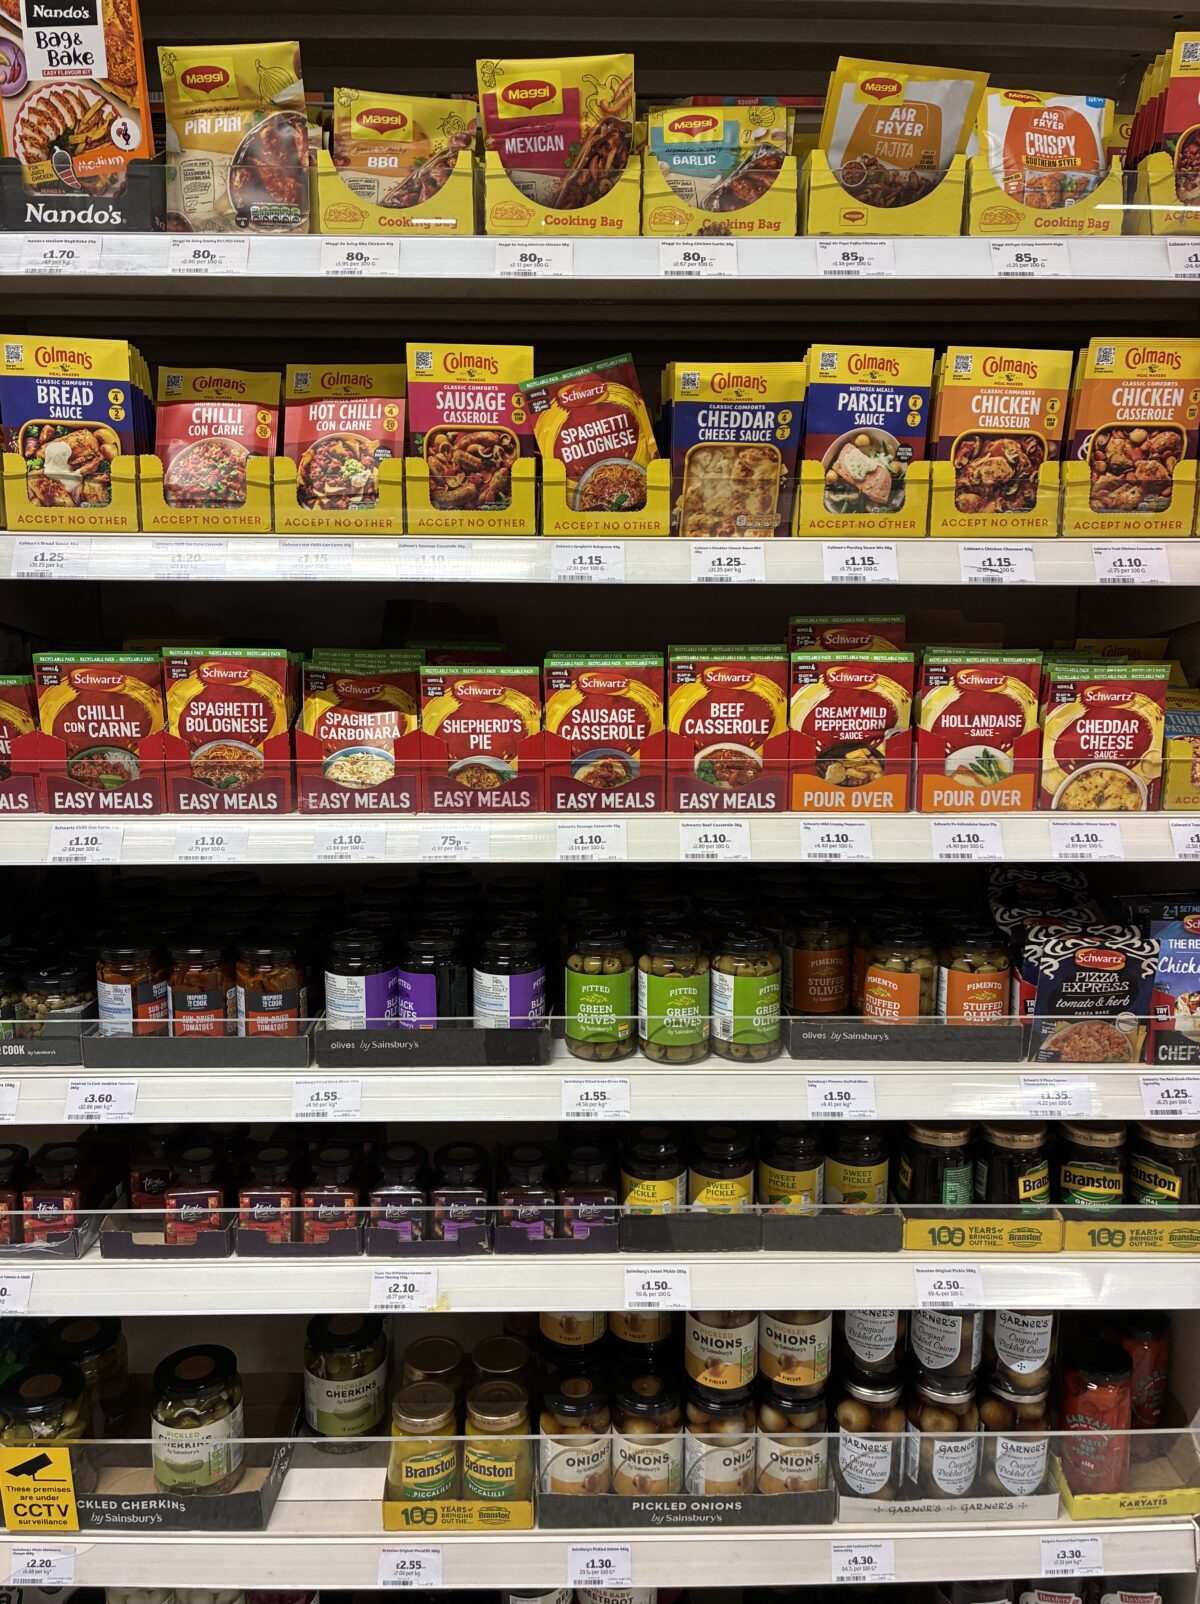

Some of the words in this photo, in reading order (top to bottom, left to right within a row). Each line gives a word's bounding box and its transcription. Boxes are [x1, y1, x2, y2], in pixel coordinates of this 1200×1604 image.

[33, 5, 89, 18] Nando's
[48, 48, 94, 67] Bake
[509, 86, 550, 100] Maggi
[866, 82, 896, 92] Maggi
[362, 115, 401, 126] Maggi
[890, 108, 916, 122] AIR
[184, 119, 211, 135] PIRI
[215, 120, 241, 133] PIRI
[875, 120, 923, 137] FRYER
[505, 135, 564, 154] MEXICAN
[875, 141, 914, 159] FAJITA
[1025, 132, 1076, 156] CRISPY
[368, 156, 398, 168] BBQ
[672, 155, 716, 165] GARLIC
[1025, 157, 1056, 166] SOUTHERN
[1058, 158, 1077, 166] STYLE
[24, 203, 122, 224] Nando's
[544, 215, 597, 228] Cooking
[600, 215, 623, 228] Bag
[1034, 218, 1084, 230] Cooking
[1087, 218, 1110, 230] Bag
[44, 250, 74, 259] £1.70
[192, 250, 216, 260] 80p
[346, 252, 369, 262] 80p
[683, 252, 706, 262] 80p
[842, 252, 865, 262] 85p
[1015, 253, 1038, 264] 85p
[35, 346, 92, 370] Colman's
[848, 354, 899, 377] Colman's
[193, 376, 246, 393] Colman's
[710, 372, 767, 394] Colman's
[37, 386, 94, 406] BREAD
[562, 385, 605, 404] Schwartz
[1112, 388, 1184, 407] CHICKEN
[436, 392, 506, 411] SAUSAGE
[838, 393, 904, 412] PARSLEY
[49, 406, 83, 419] SAUCE
[192, 408, 242, 424] CHILLI
[309, 404, 336, 420] HOT
[340, 404, 381, 419] CHILLI
[443, 411, 499, 424] CASSEROLE
[1116, 409, 1174, 420] CASSEROLE
[698, 410, 775, 429] CHEDDAR
[854, 413, 885, 425] SAUCE
[979, 416, 1030, 428] CHASSEUR
[188, 425, 207, 436] CON
[211, 425, 244, 436] CARNE
[316, 421, 337, 431] CON
[340, 421, 372, 431] CARNE
[561, 414, 628, 445] SPAGHETTI
[698, 429, 736, 441] CHEESE
[739, 430, 772, 441] SAUCE
[561, 429, 636, 464] BOLOGNESE
[18, 515, 64, 524] ACCEPT
[69, 516, 85, 524] NO
[88, 516, 127, 525] OTHER
[34, 552, 64, 562] £1.25
[712, 557, 741, 567] £1.25
[845, 557, 874, 566] £1.15
[982, 558, 1011, 567] £1.15
[1113, 558, 1142, 568] £1.10
[202, 667, 249, 678] Schwartz
[828, 672, 874, 683] Schwartz
[74, 674, 121, 685] Schwartz
[77, 705, 125, 720] CHILLI
[190, 703, 263, 717] SPAGHETTI
[710, 703, 745, 717] BEEF
[815, 707, 859, 718] CREAMY
[861, 707, 886, 718] MILD
[326, 712, 396, 726] SPAGHETTI
[572, 709, 635, 724] SAUSAGE
[941, 714, 1022, 728] HOLLANDAISE
[64, 723, 85, 733] CON
[88, 722, 141, 737] CARNE
[186, 717, 268, 733] BOLOGNESE
[443, 719, 522, 734] SHEPHERD'S
[685, 719, 769, 735] CASSEROLE
[815, 719, 886, 731] PEPPERCORN
[1076, 719, 1139, 734] CHEDDAR
[320, 726, 400, 740] CARBONARA
[840, 732, 863, 740] SAUCE
[470, 735, 492, 750] PIE
[1080, 735, 1134, 750] CHEESE
[54, 792, 94, 809] EASY
[99, 793, 153, 809] MEALS
[804, 792, 845, 808] POUR
[851, 792, 893, 808] OVER
[69, 837, 98, 846] £1.10
[441, 836, 461, 846] 75p
[810, 958, 843, 967] PIMENTO
[808, 976, 844, 986] STUFFED
[1076, 972, 1119, 982] PIZZA
[581, 985, 610, 993] PITTED
[809, 985, 844, 996] OLIVES
[1062, 982, 1129, 993] EXPRESS
[1056, 998, 1093, 1008] tomato
[1096, 998, 1104, 1007] &
[1106, 996, 1130, 1006] herb
[579, 1005, 613, 1014] GREEN
[182, 1023, 214, 1031] TOMATOES
[331, 1040, 355, 1049] olives
[360, 1040, 370, 1050] by
[372, 1040, 419, 1050] Sainsbury's
[85, 1094, 112, 1104] £3.60
[580, 1092, 606, 1101] £1.55
[824, 1092, 850, 1100] £1.50
[1161, 1089, 1188, 1099] £1.25
[843, 1169, 872, 1178] SWEET
[1063, 1169, 1121, 1190] Branston
[843, 1176, 872, 1184] PICKLE
[630, 1190, 656, 1198] PICKLE
[928, 1226, 965, 1246] 100
[1008, 1233, 1042, 1242] Branston
[389, 1284, 415, 1293] £2.10
[641, 1281, 668, 1291] £1.50
[933, 1280, 960, 1290] £2.50
[692, 1330, 742, 1349] ONIONS
[326, 1380, 377, 1398] GHERKINS
[405, 1456, 455, 1478] Branston
[33, 1486, 71, 1494] premises
[413, 1483, 451, 1498] PICCALILLI
[77, 1500, 117, 1509] CKLED
[122, 1500, 186, 1511] GHERKINS
[632, 1502, 687, 1511] PICKLED
[691, 1502, 742, 1511] ONIONS
[888, 1505, 941, 1514] GARNER'S
[961, 1502, 1013, 1511] GARNER'S
[1119, 1498, 1168, 1507] KARYATIS
[14, 1504, 69, 1517] CCTV
[91, 1513, 103, 1524] by
[106, 1513, 162, 1524] Sainsbury's
[651, 1513, 664, 1522] by
[666, 1513, 722, 1522] Sainsbury's
[1057, 1549, 1082, 1560] £3.30
[27, 1559, 51, 1568] £2.20
[396, 1561, 422, 1570] £2.55
[586, 1559, 612, 1569] £1.30
[848, 1556, 873, 1566] £4.30
